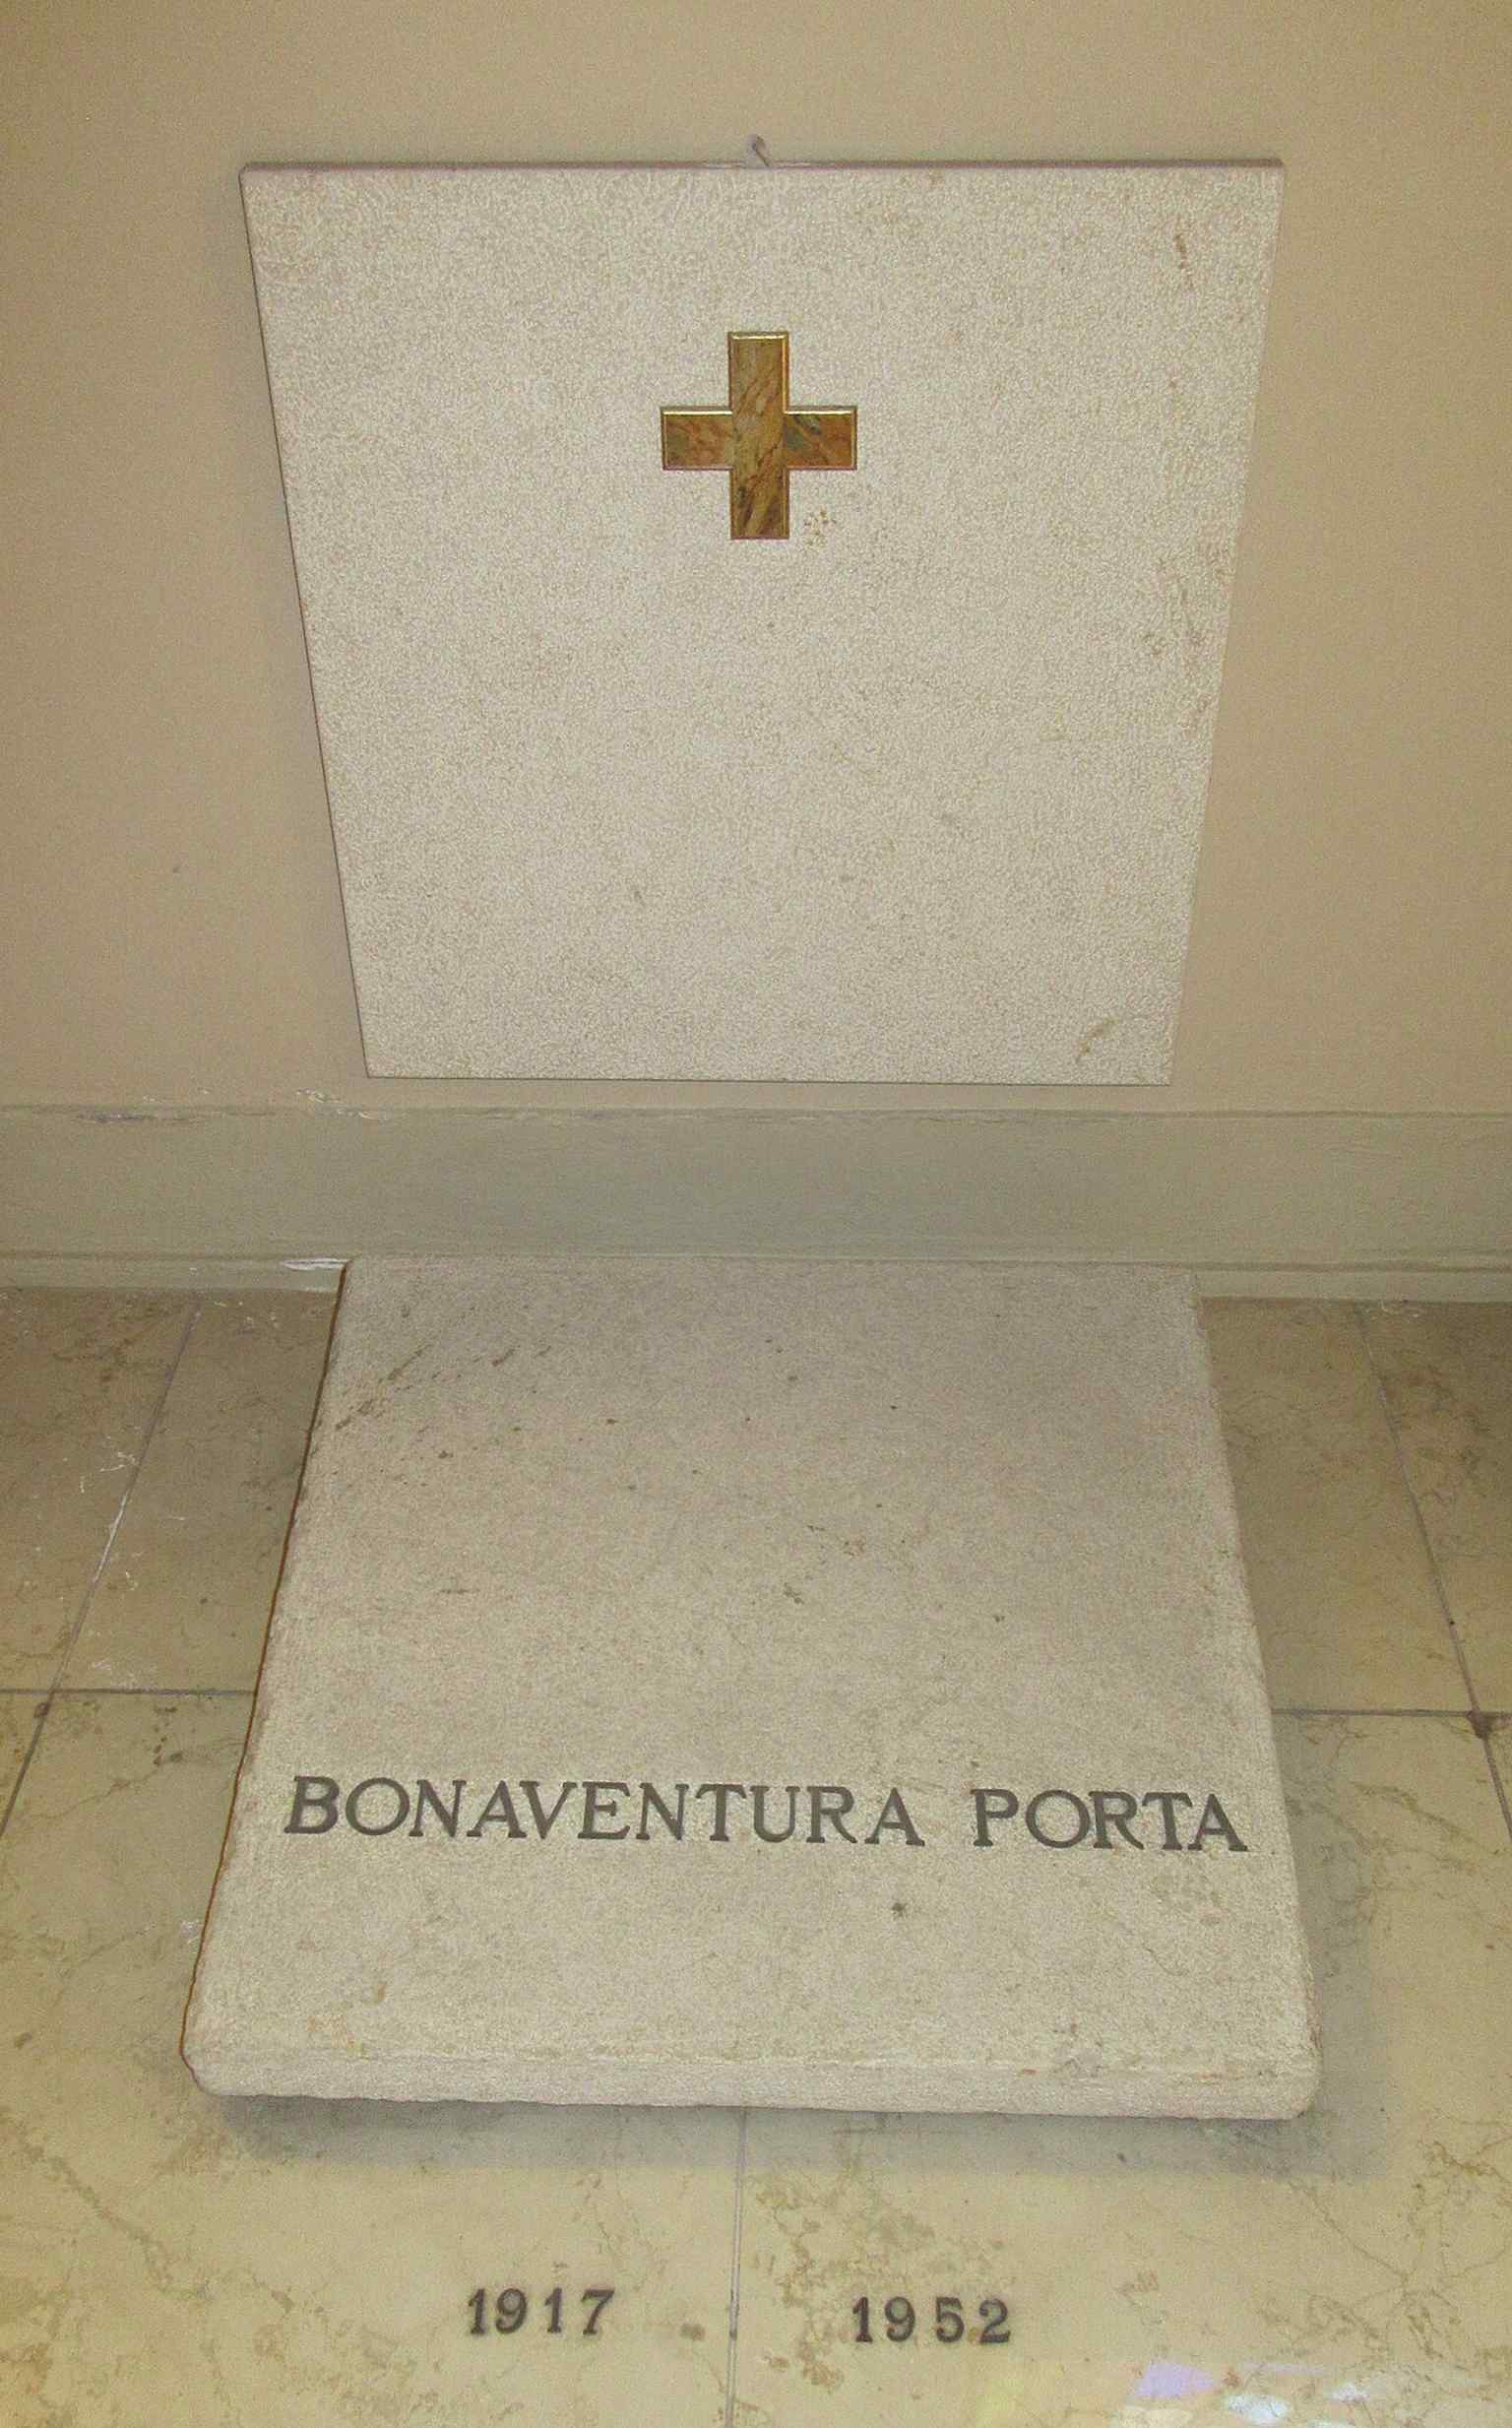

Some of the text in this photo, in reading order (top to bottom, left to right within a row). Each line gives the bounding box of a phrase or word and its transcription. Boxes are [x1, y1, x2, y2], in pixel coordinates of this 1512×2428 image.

[284, 1775, 1249, 1852] BONAVENTURA PORTA
[467, 2287, 615, 2336] 1917
[850, 2296, 1012, 2345] 1952
